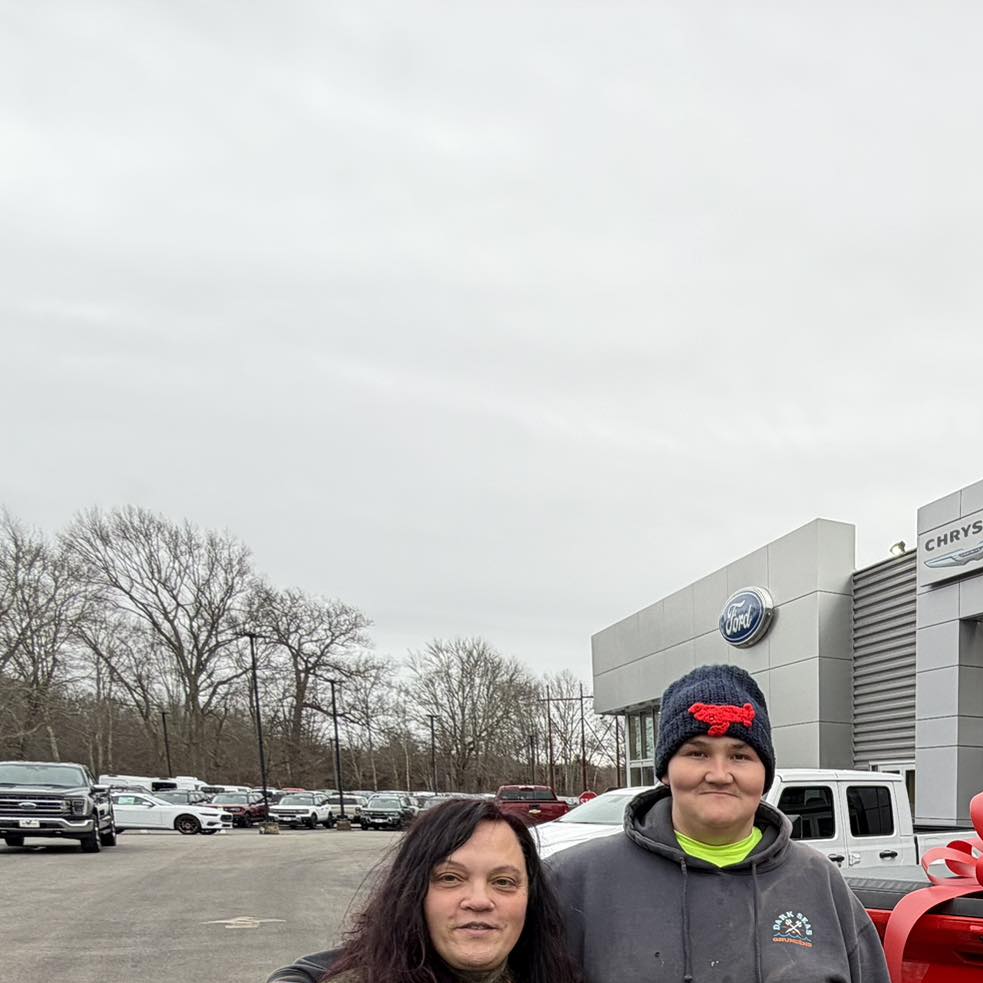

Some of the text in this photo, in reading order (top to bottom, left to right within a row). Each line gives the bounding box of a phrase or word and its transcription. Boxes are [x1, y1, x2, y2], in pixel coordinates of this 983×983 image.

[725, 599, 753, 636] Ford
[772, 911, 813, 936] DARK SEAS
